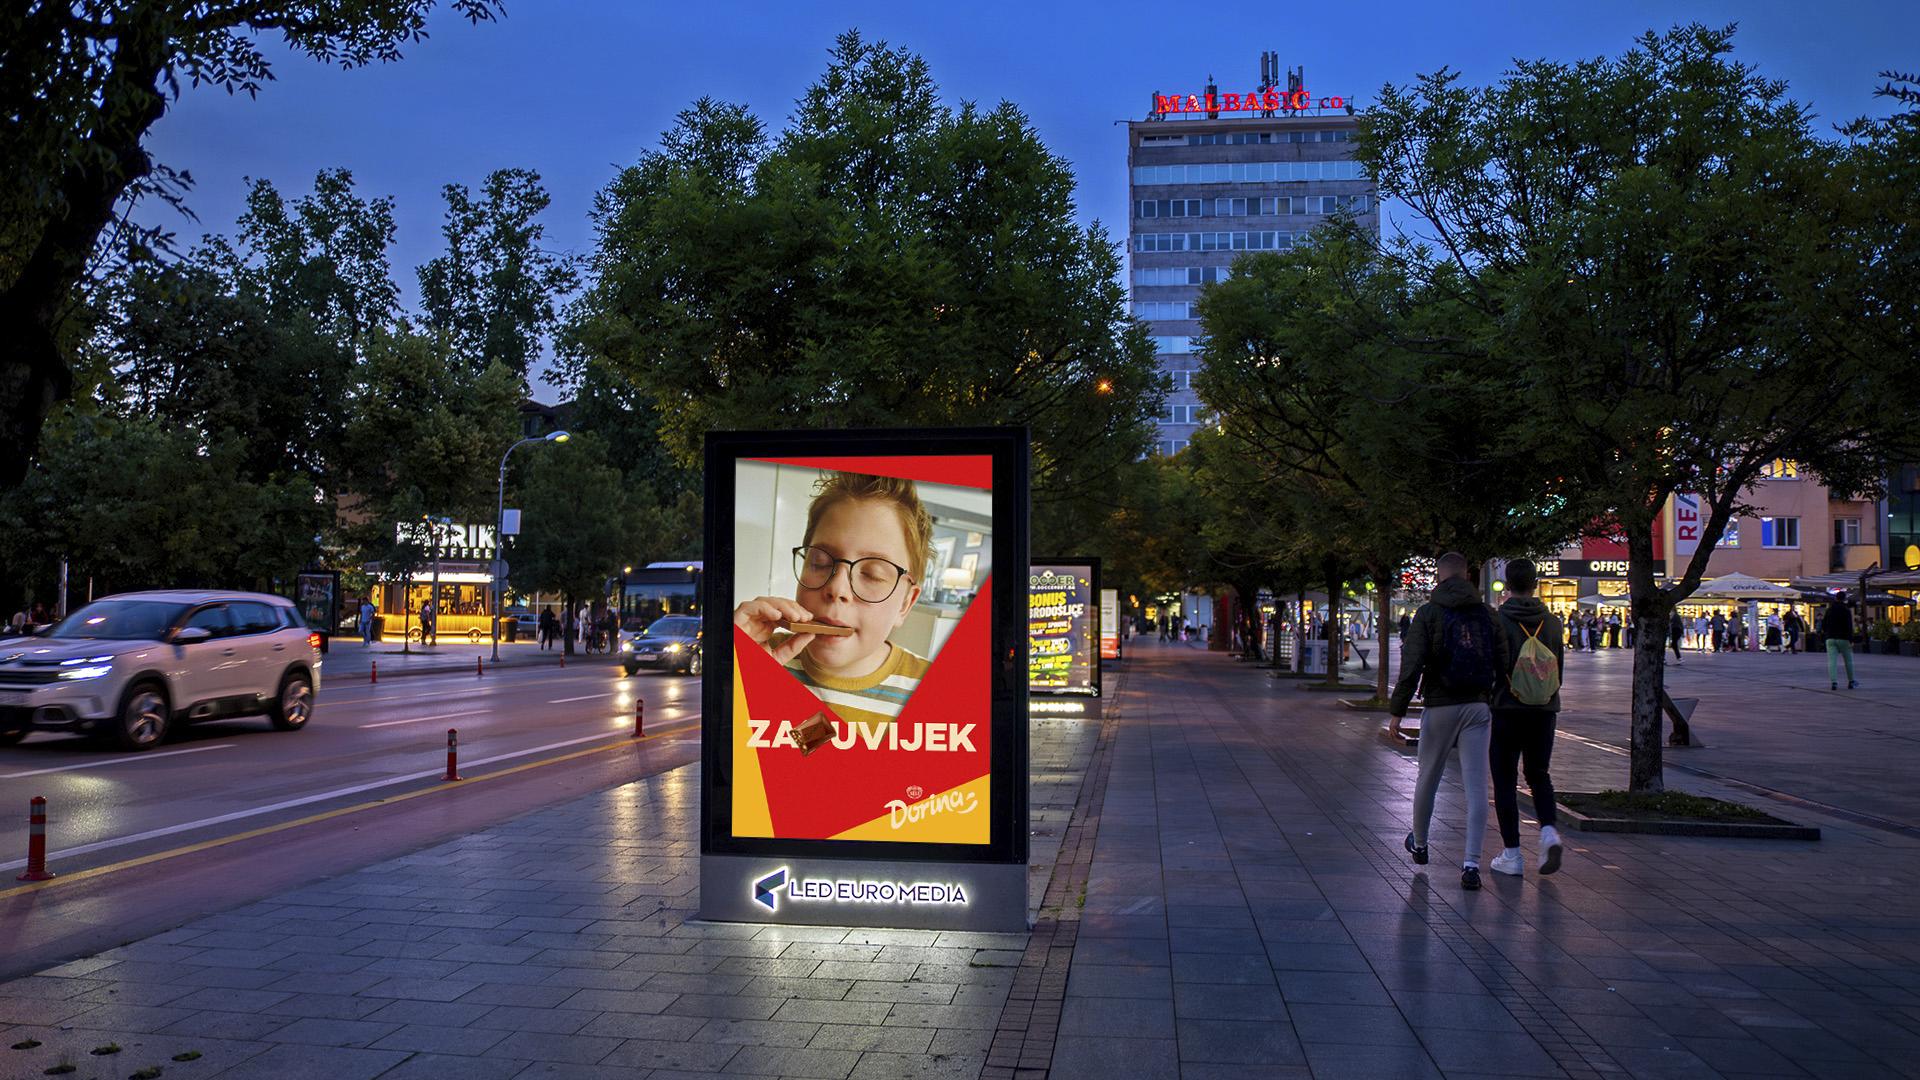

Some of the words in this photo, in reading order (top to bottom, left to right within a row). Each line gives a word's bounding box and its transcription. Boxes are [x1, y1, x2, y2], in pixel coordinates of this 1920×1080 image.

[396, 521, 516, 549] FABRIK
[1536, 561, 1560, 572] FICE
[883, 790, 966, 830] Dorina
[790, 880, 833, 899] LED
[837, 882, 895, 901] EURO
[898, 884, 966, 904] MEDIA
